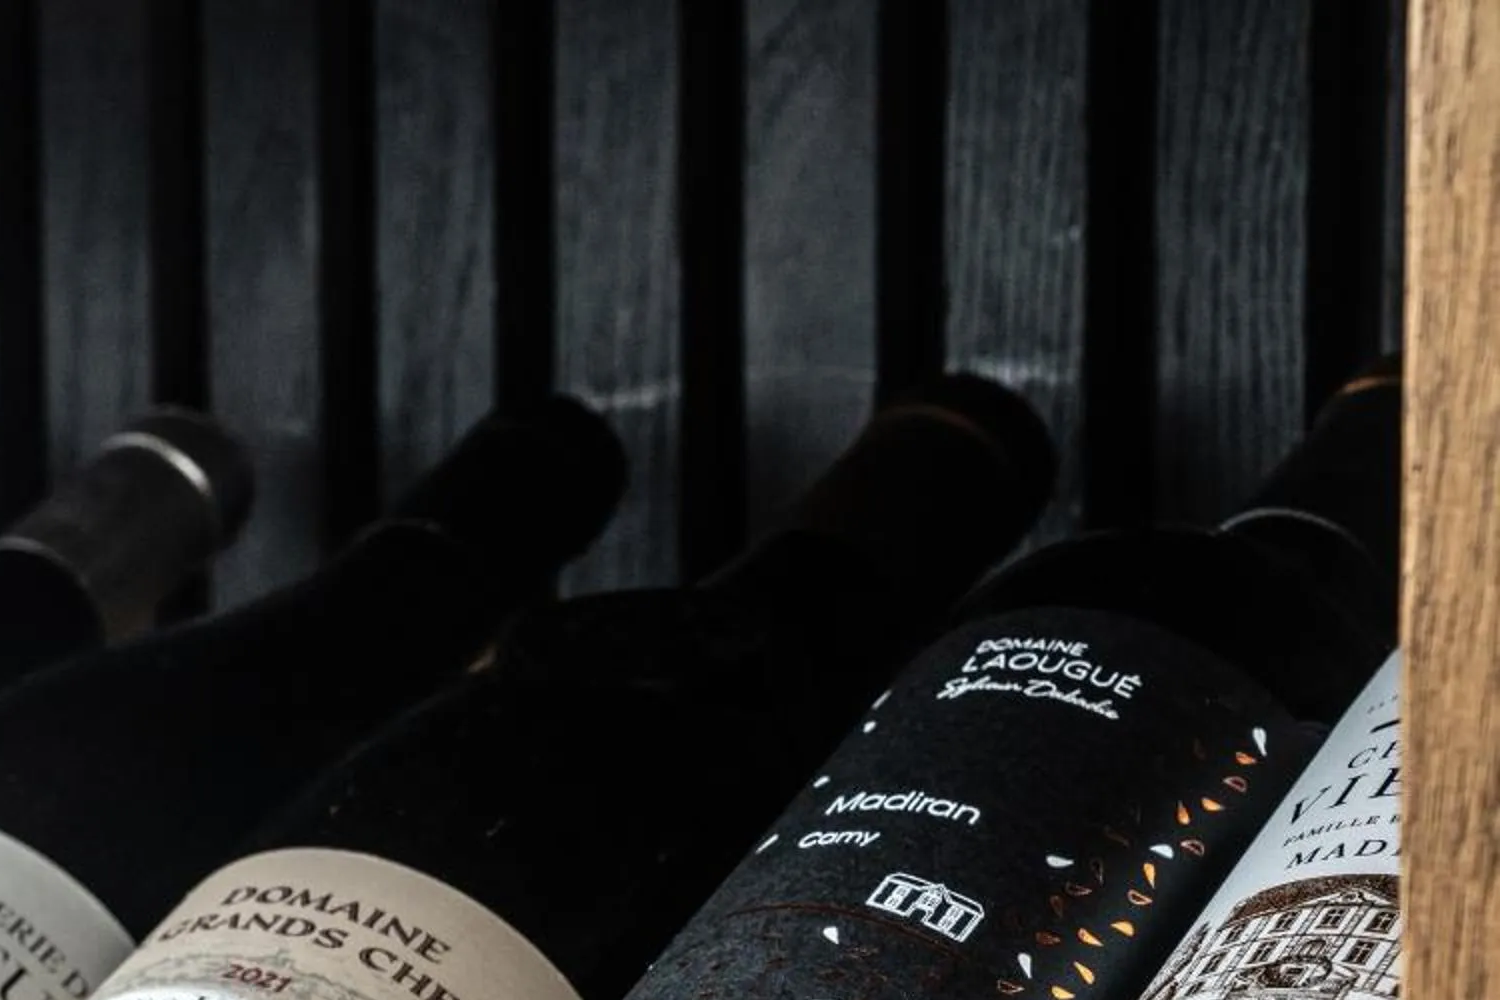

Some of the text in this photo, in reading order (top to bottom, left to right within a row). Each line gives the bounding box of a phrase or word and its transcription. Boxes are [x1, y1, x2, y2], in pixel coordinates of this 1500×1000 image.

[976, 637, 1088, 657] DOMAINE
[962, 652, 1143, 699] LAOUGUÉ
[825, 790, 981, 825] Madiran
[1283, 815, 1380, 846] FAMILLE
[1285, 839, 1402, 869] MAD
[159, 912, 349, 950] GRANDS
[221, 885, 451, 964] DOMAINE
[221, 963, 294, 993] 2021
